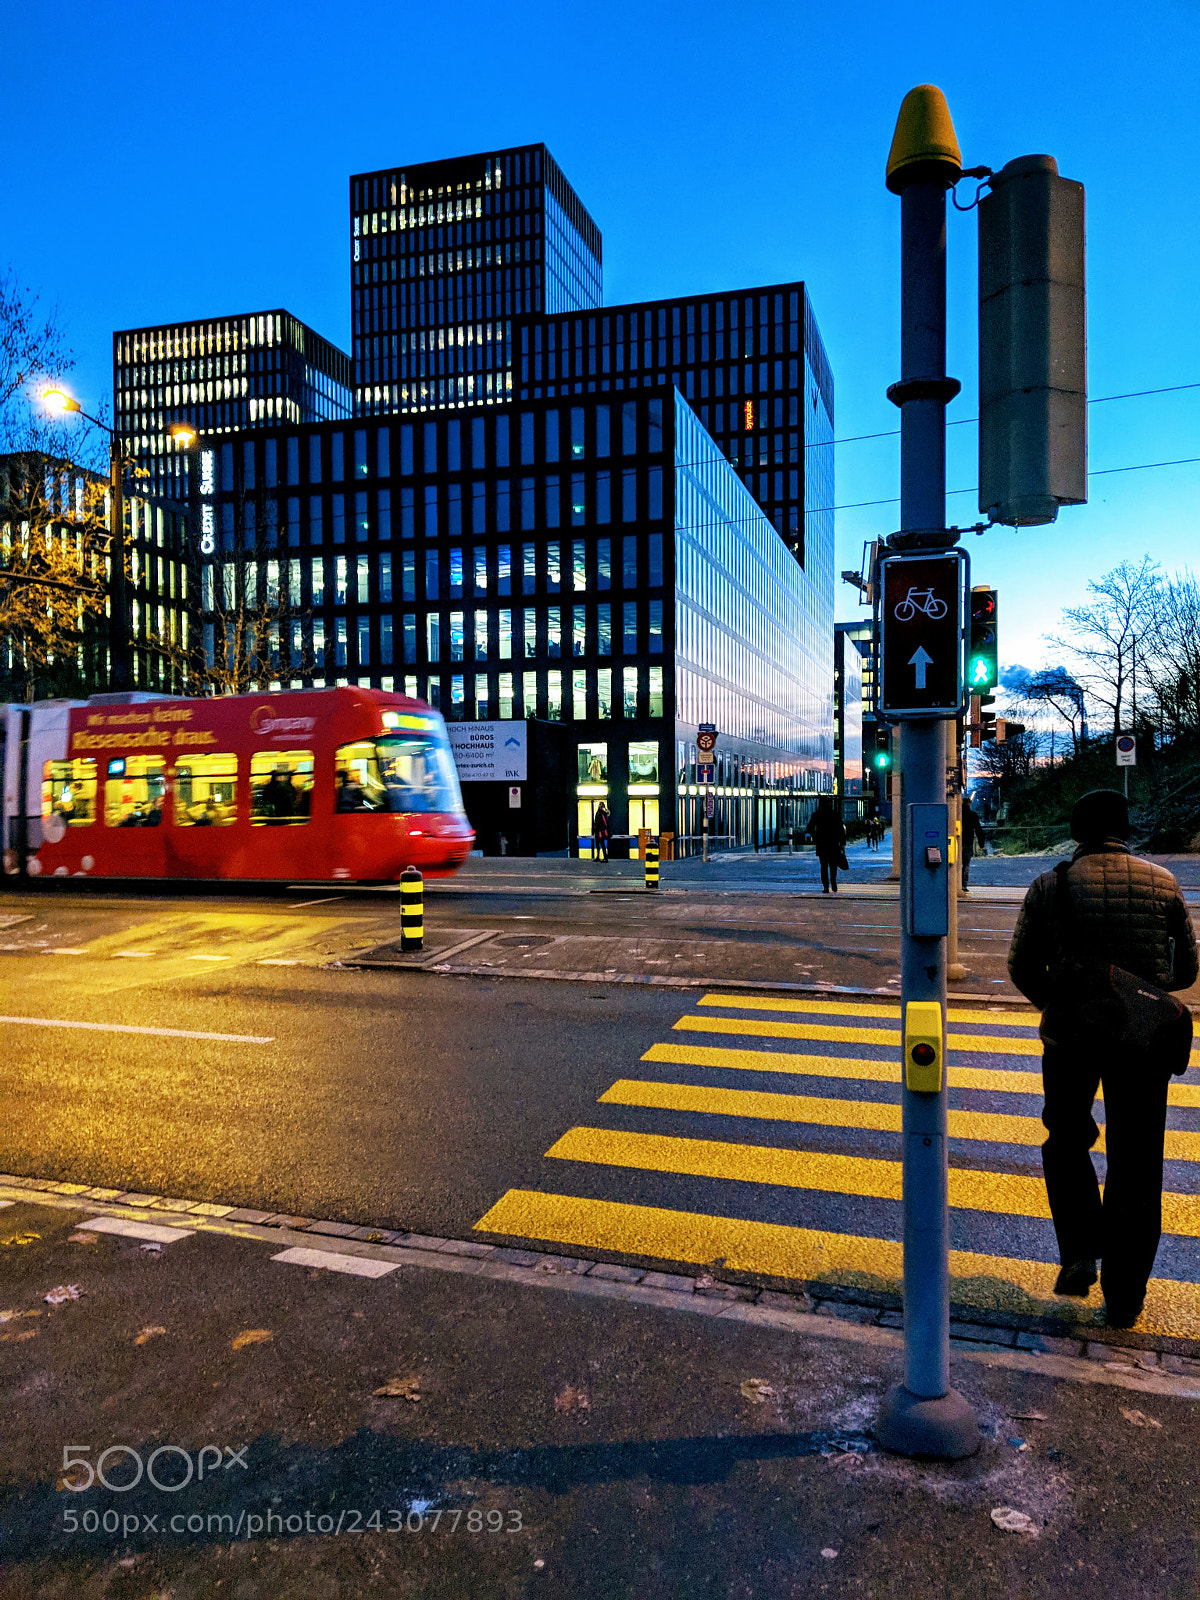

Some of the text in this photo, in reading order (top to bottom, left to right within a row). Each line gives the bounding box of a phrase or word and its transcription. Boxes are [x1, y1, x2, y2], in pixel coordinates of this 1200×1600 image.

[200, 449, 215, 555] CREDIT SUISSE
[470, 733, 494, 741] BÜROS
